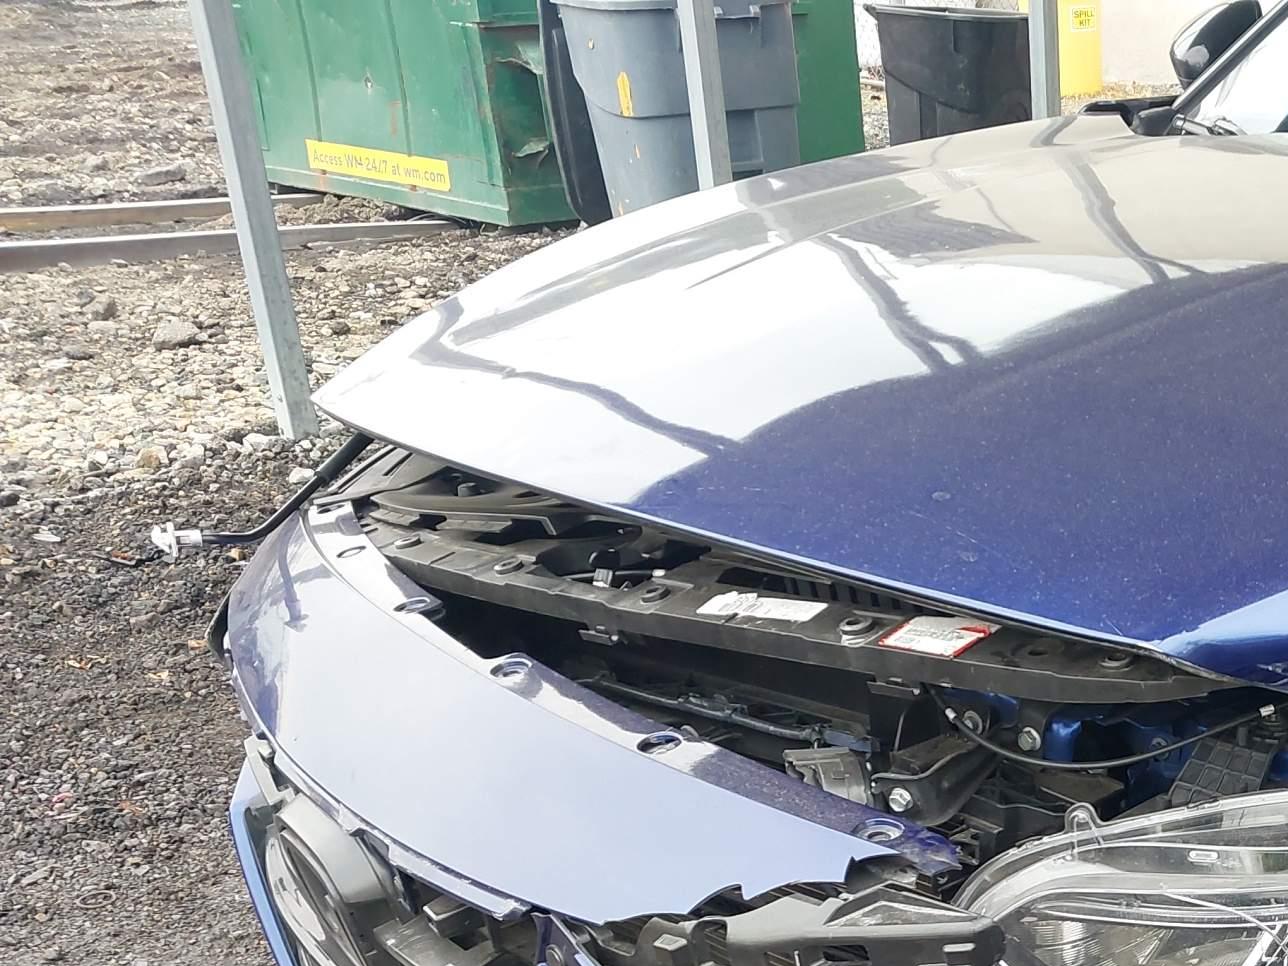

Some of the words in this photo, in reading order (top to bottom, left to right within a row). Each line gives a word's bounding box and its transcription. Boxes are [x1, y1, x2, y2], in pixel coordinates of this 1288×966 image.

[1073, 9, 1094, 18] SPILL
[313, 149, 342, 166] Access
[391, 163, 401, 176] at
[403, 168, 446, 185] wm.com
